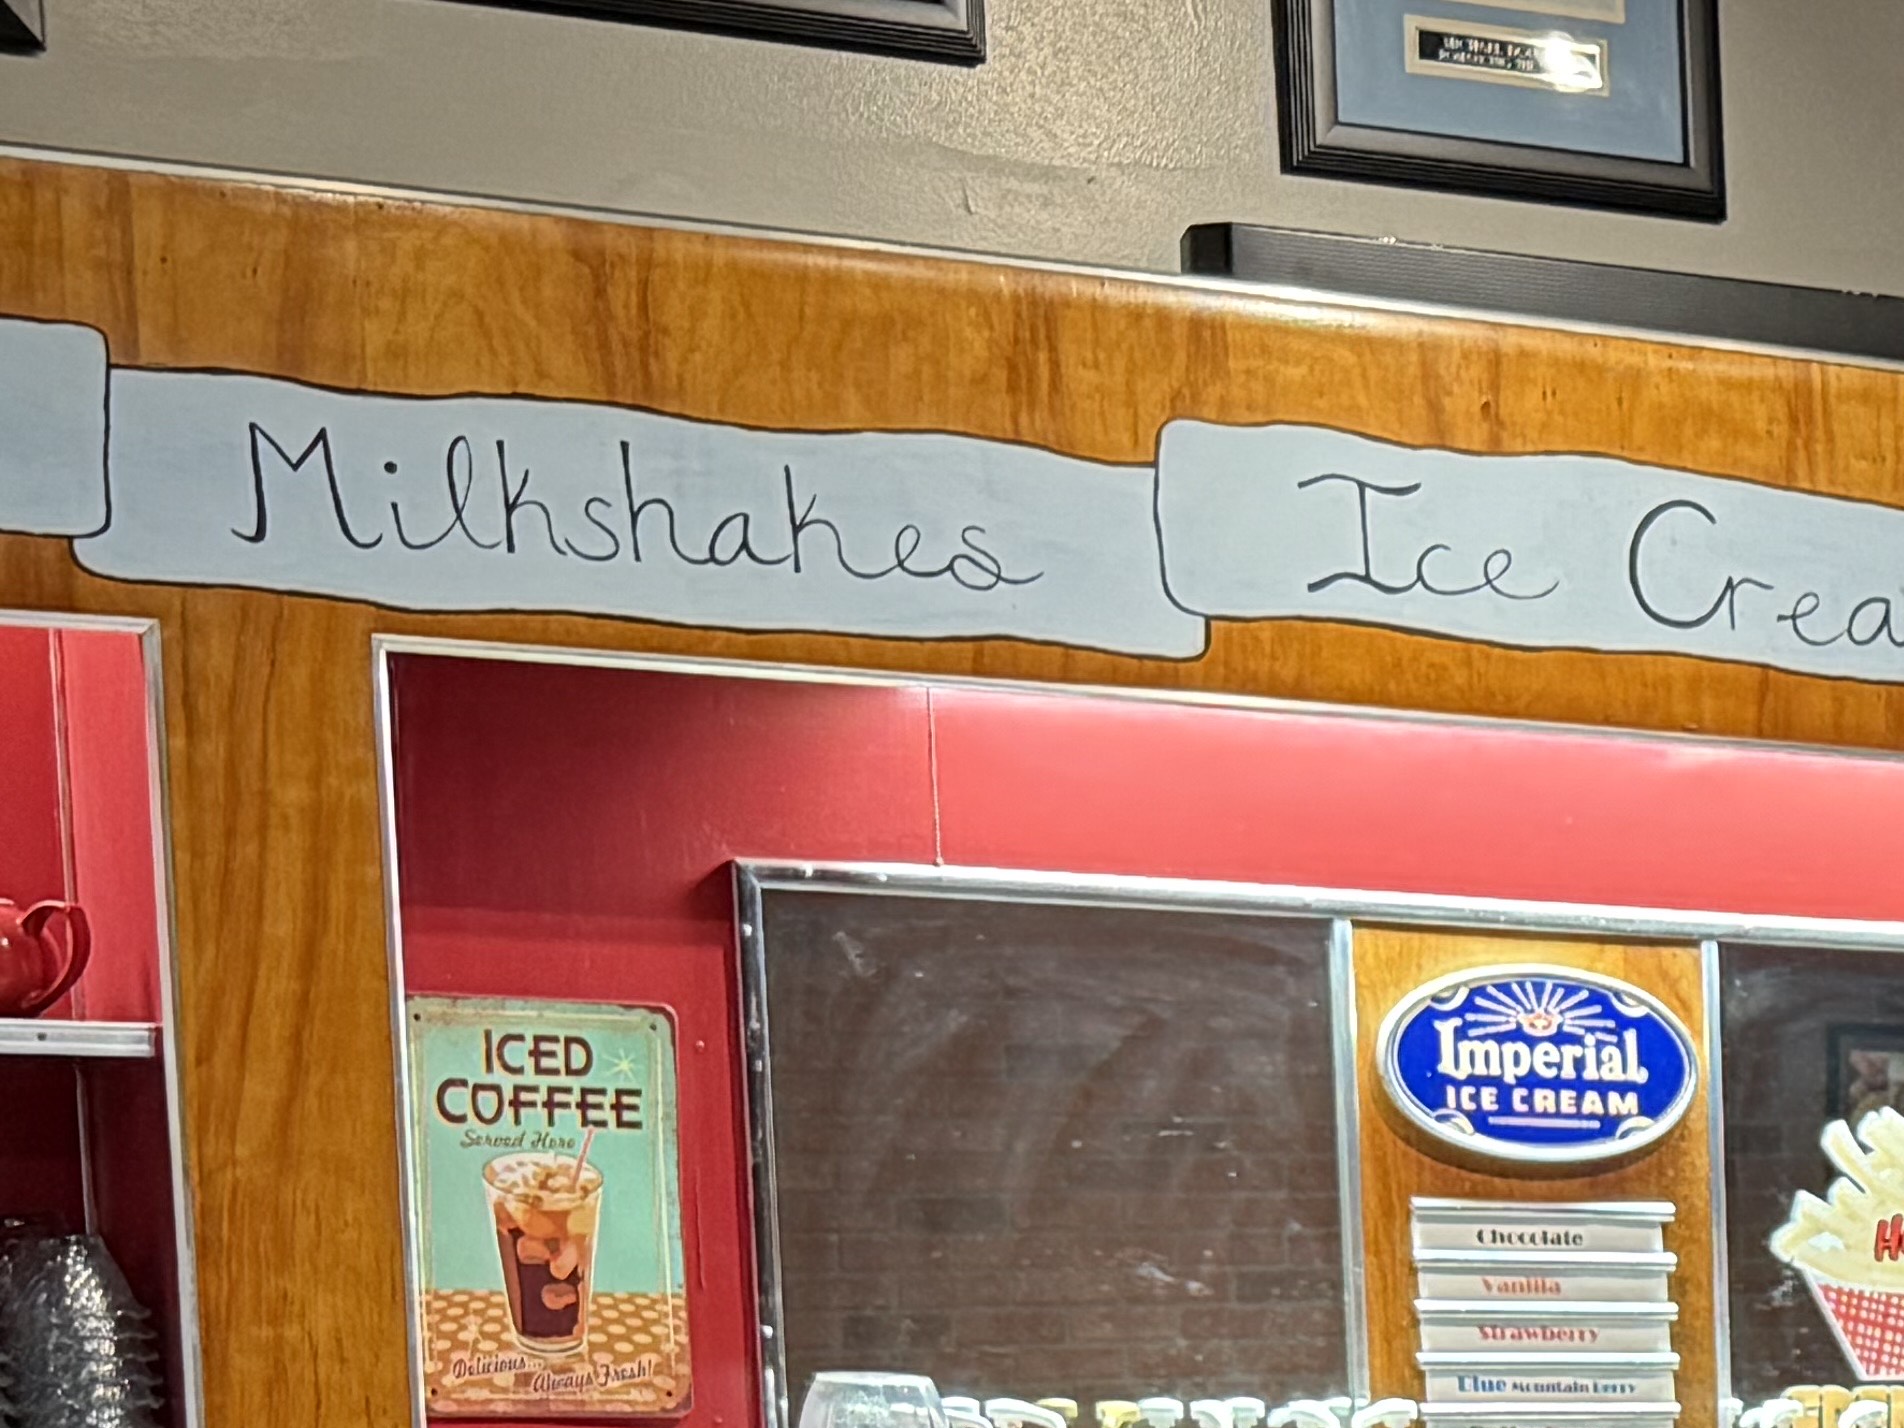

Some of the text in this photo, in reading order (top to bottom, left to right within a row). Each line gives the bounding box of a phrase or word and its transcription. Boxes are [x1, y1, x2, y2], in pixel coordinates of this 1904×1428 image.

[232, 421, 1044, 590] Milkshakes
[1298, 475, 1559, 597] Ice
[484, 1028, 594, 1077] ICED
[1435, 1019, 1649, 1083] Imperial
[436, 1077, 643, 1129] COFFEE
[1446, 1086, 1639, 1116] ICE CREAM
[460, 1129, 576, 1149] Served Here
[1476, 1228, 1584, 1247] Chocolate
[1481, 1276, 1562, 1295] Vanilla
[1477, 1324, 1600, 1344] Strawberry
[532, 1371, 594, 1393] Always
[1457, 1374, 1507, 1393] Blue
